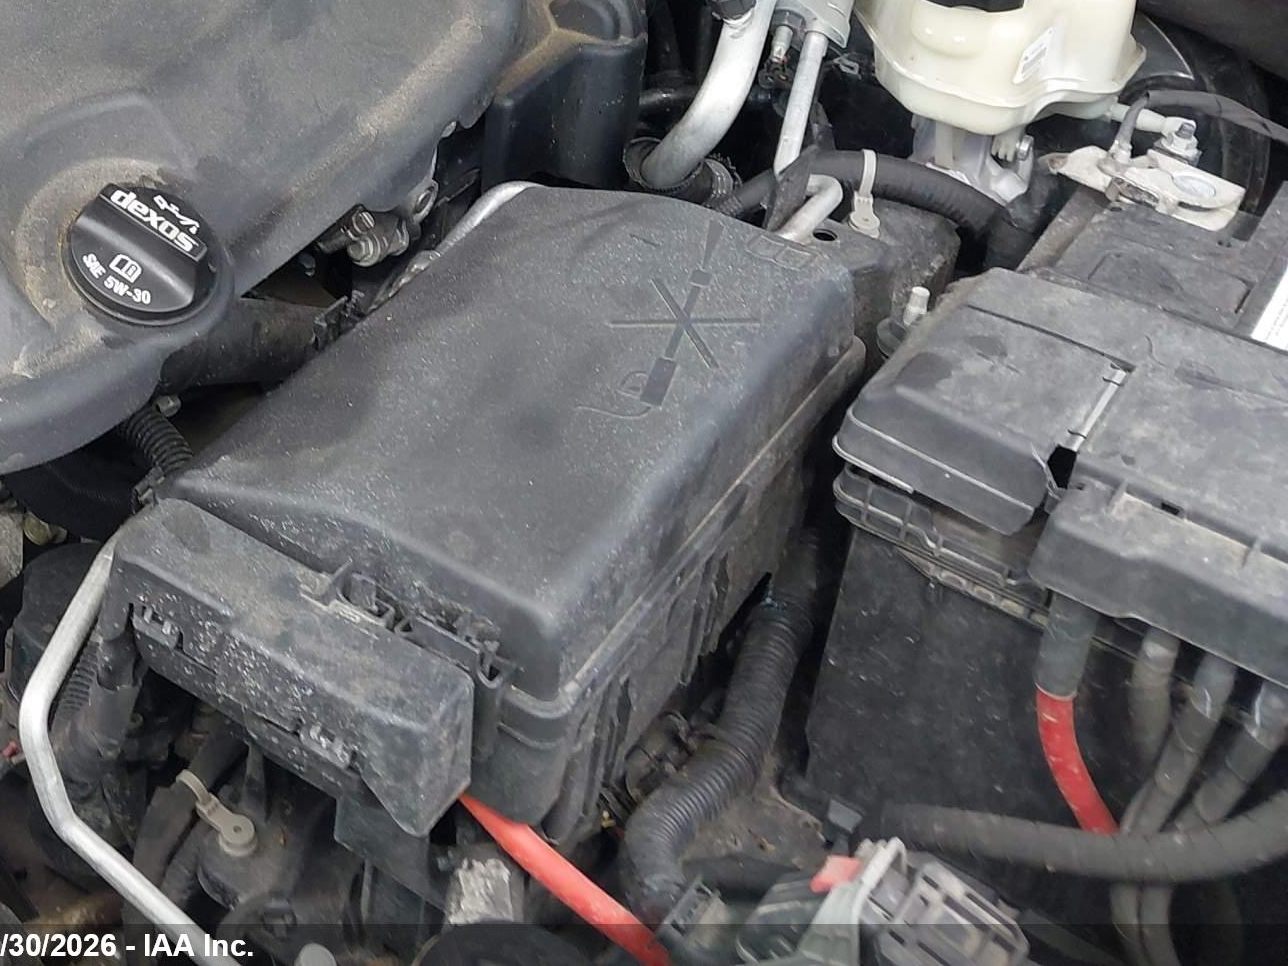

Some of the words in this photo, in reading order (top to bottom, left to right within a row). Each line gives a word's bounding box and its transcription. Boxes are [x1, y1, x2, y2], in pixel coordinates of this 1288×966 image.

[110, 189, 200, 253] dexos
[82, 253, 107, 279] SAE
[103, 275, 152, 305] 5W-30
